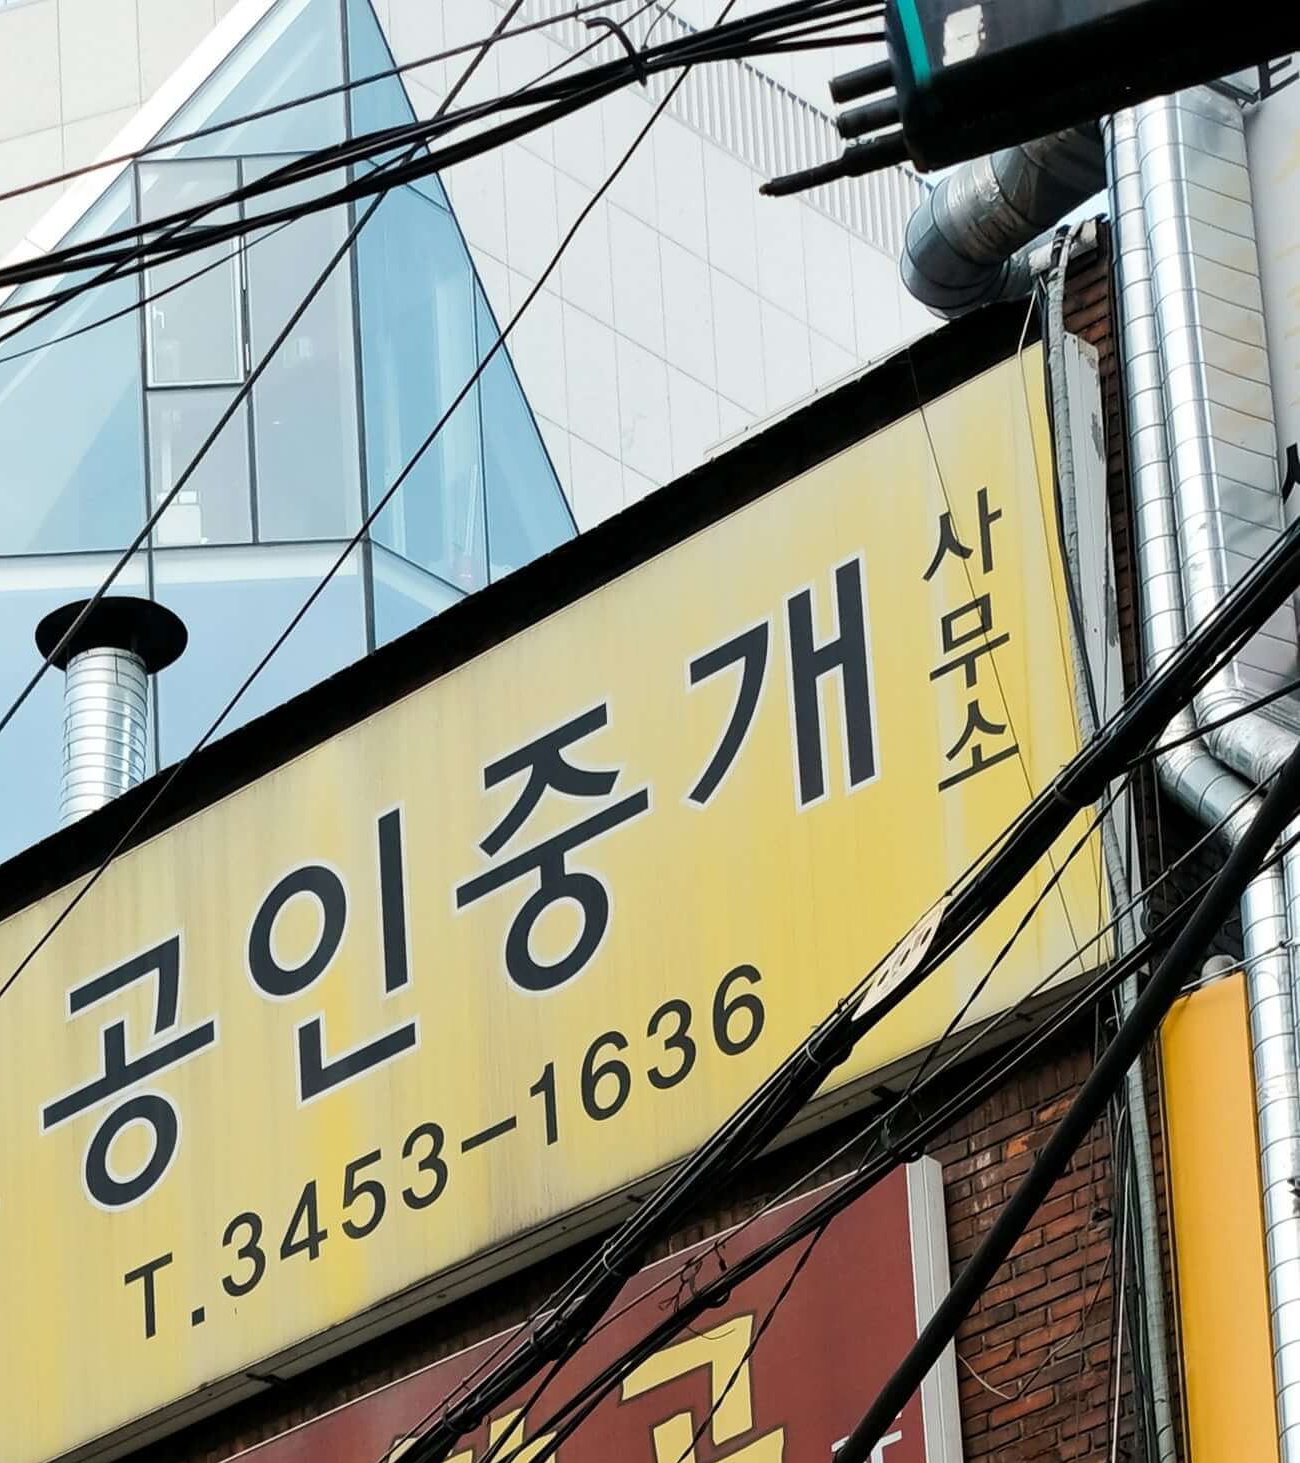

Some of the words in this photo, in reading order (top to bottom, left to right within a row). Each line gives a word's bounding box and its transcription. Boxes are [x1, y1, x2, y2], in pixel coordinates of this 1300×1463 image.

[922, 485, 1020, 792] 사무소
[43, 554, 881, 1214] 공인중개
[123, 962, 770, 1339] T.3453-1636
